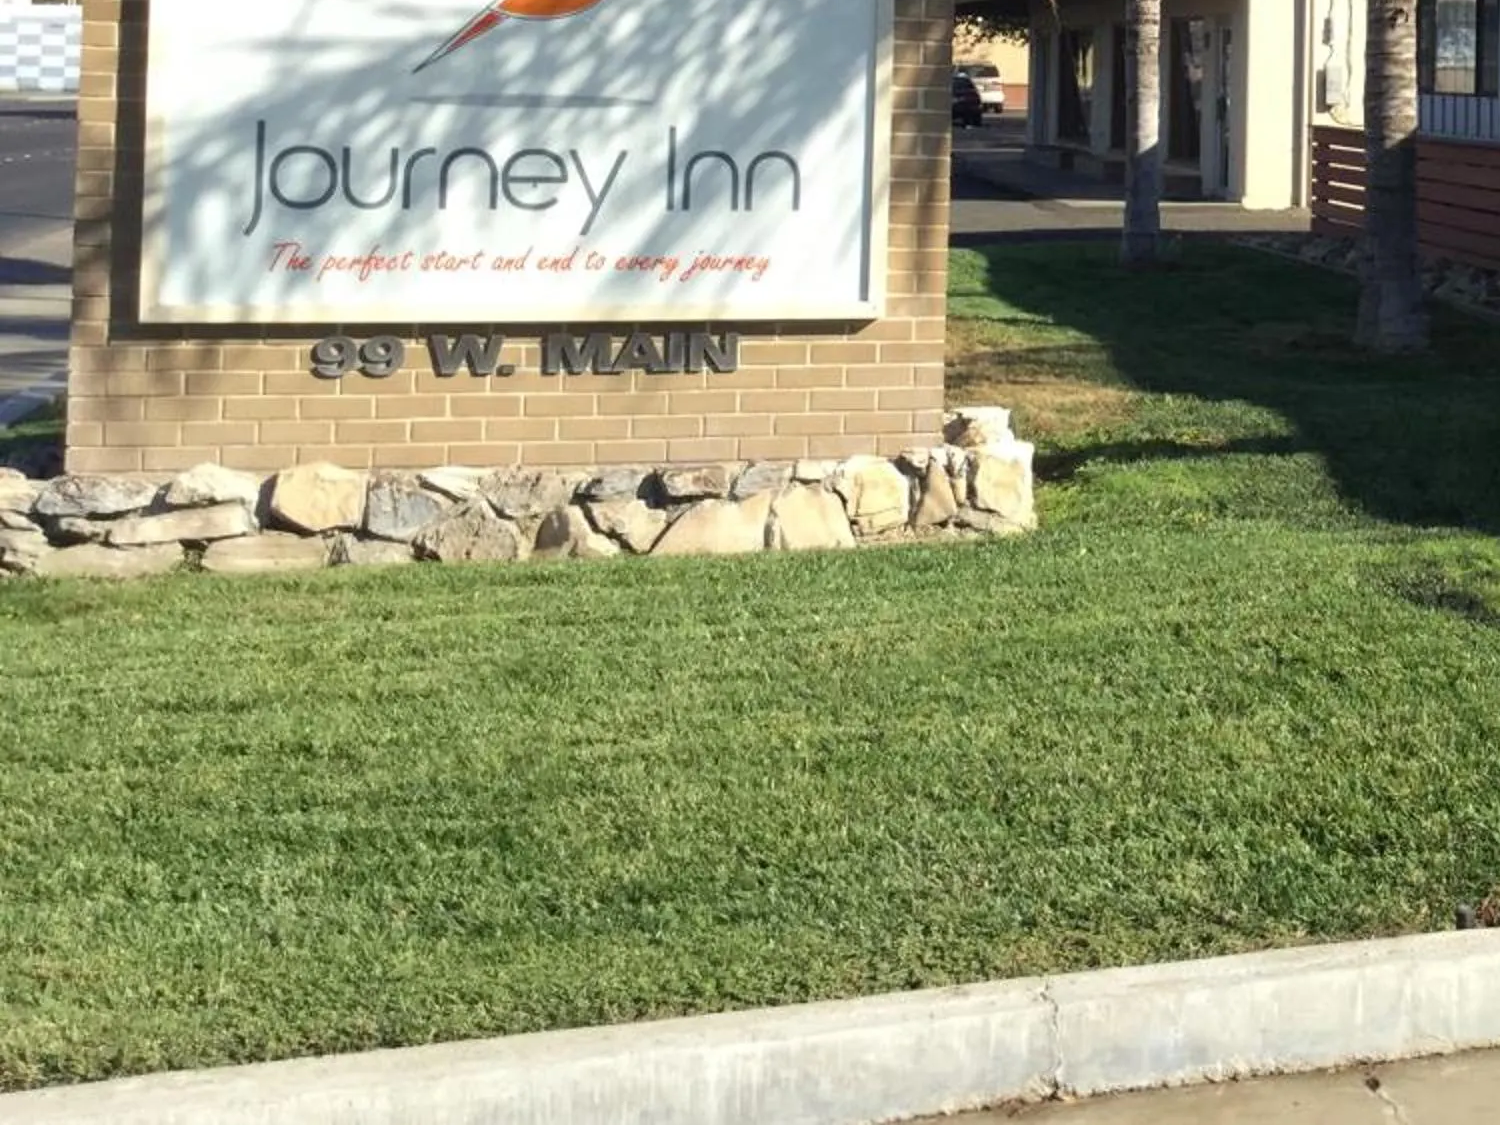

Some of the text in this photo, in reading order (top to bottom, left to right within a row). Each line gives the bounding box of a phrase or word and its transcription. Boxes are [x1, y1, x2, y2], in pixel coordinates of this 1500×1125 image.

[243, 119, 800, 235] Journey Inn
[269, 241, 770, 282] The perfect start and end to every journey
[311, 331, 741, 379] 99 W. MAIN
